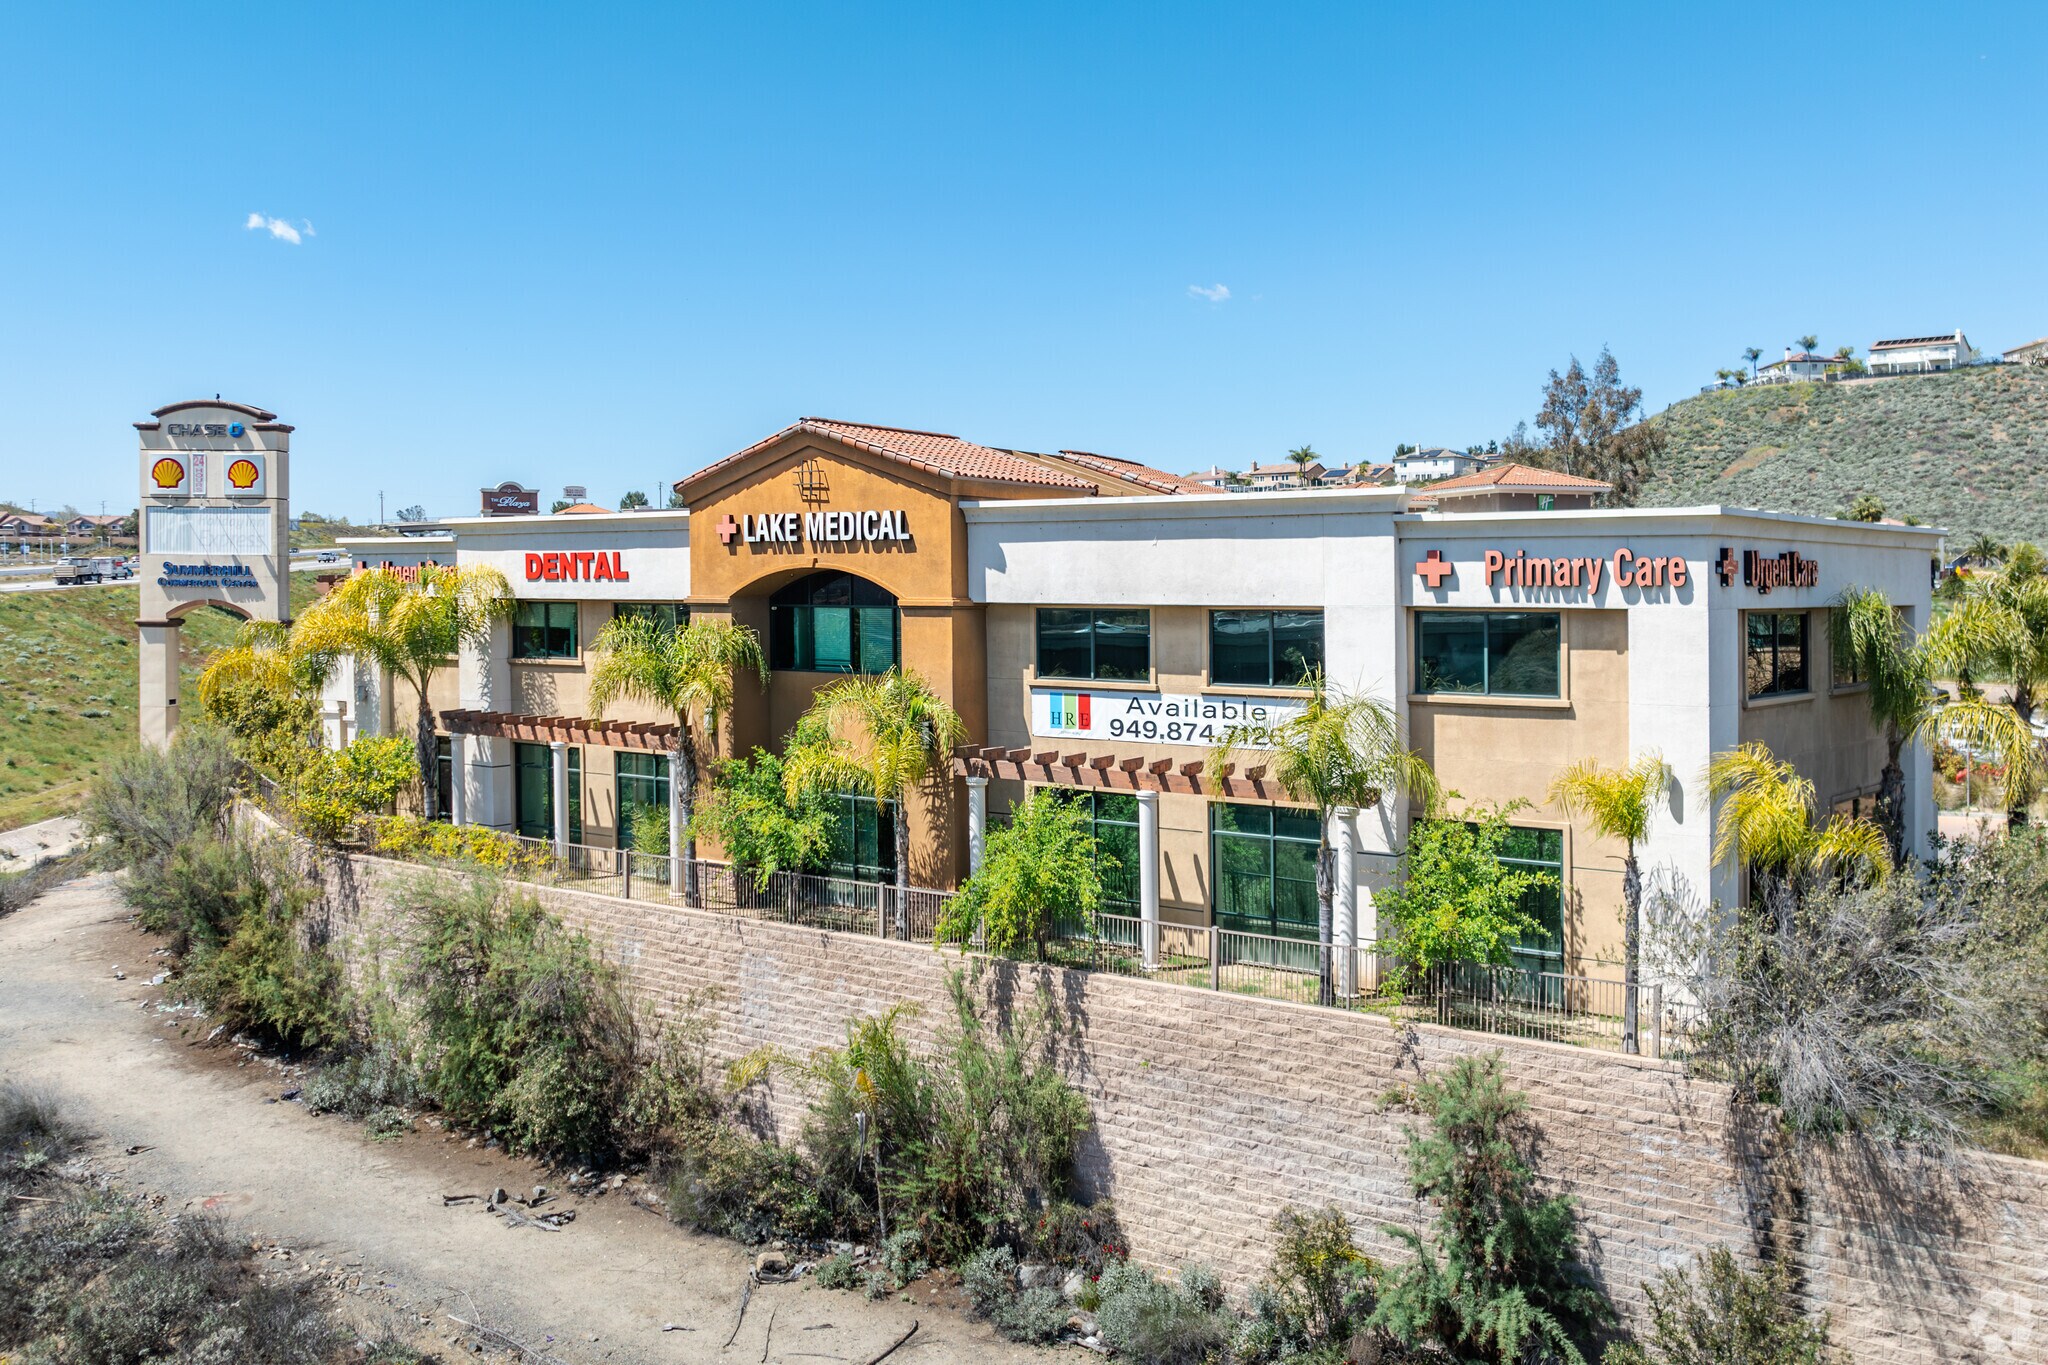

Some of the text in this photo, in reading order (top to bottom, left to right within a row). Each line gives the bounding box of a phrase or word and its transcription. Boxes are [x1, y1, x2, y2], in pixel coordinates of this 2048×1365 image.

[168, 424, 227, 437] CHASE
[193, 455, 204, 466] 24
[196, 468, 204, 492] HOURS
[497, 496, 531, 508] Plaza
[743, 510, 911, 542] LAKE MEDICAL
[163, 561, 253, 576] SUMMERHILL
[525, 551, 629, 580] DENTAL
[1485, 548, 1687, 595] Primary Care
[1745, 550, 1819, 594] Urgent Care
[1051, 711, 1089, 727] HRE
[1126, 696, 1267, 721] Available
